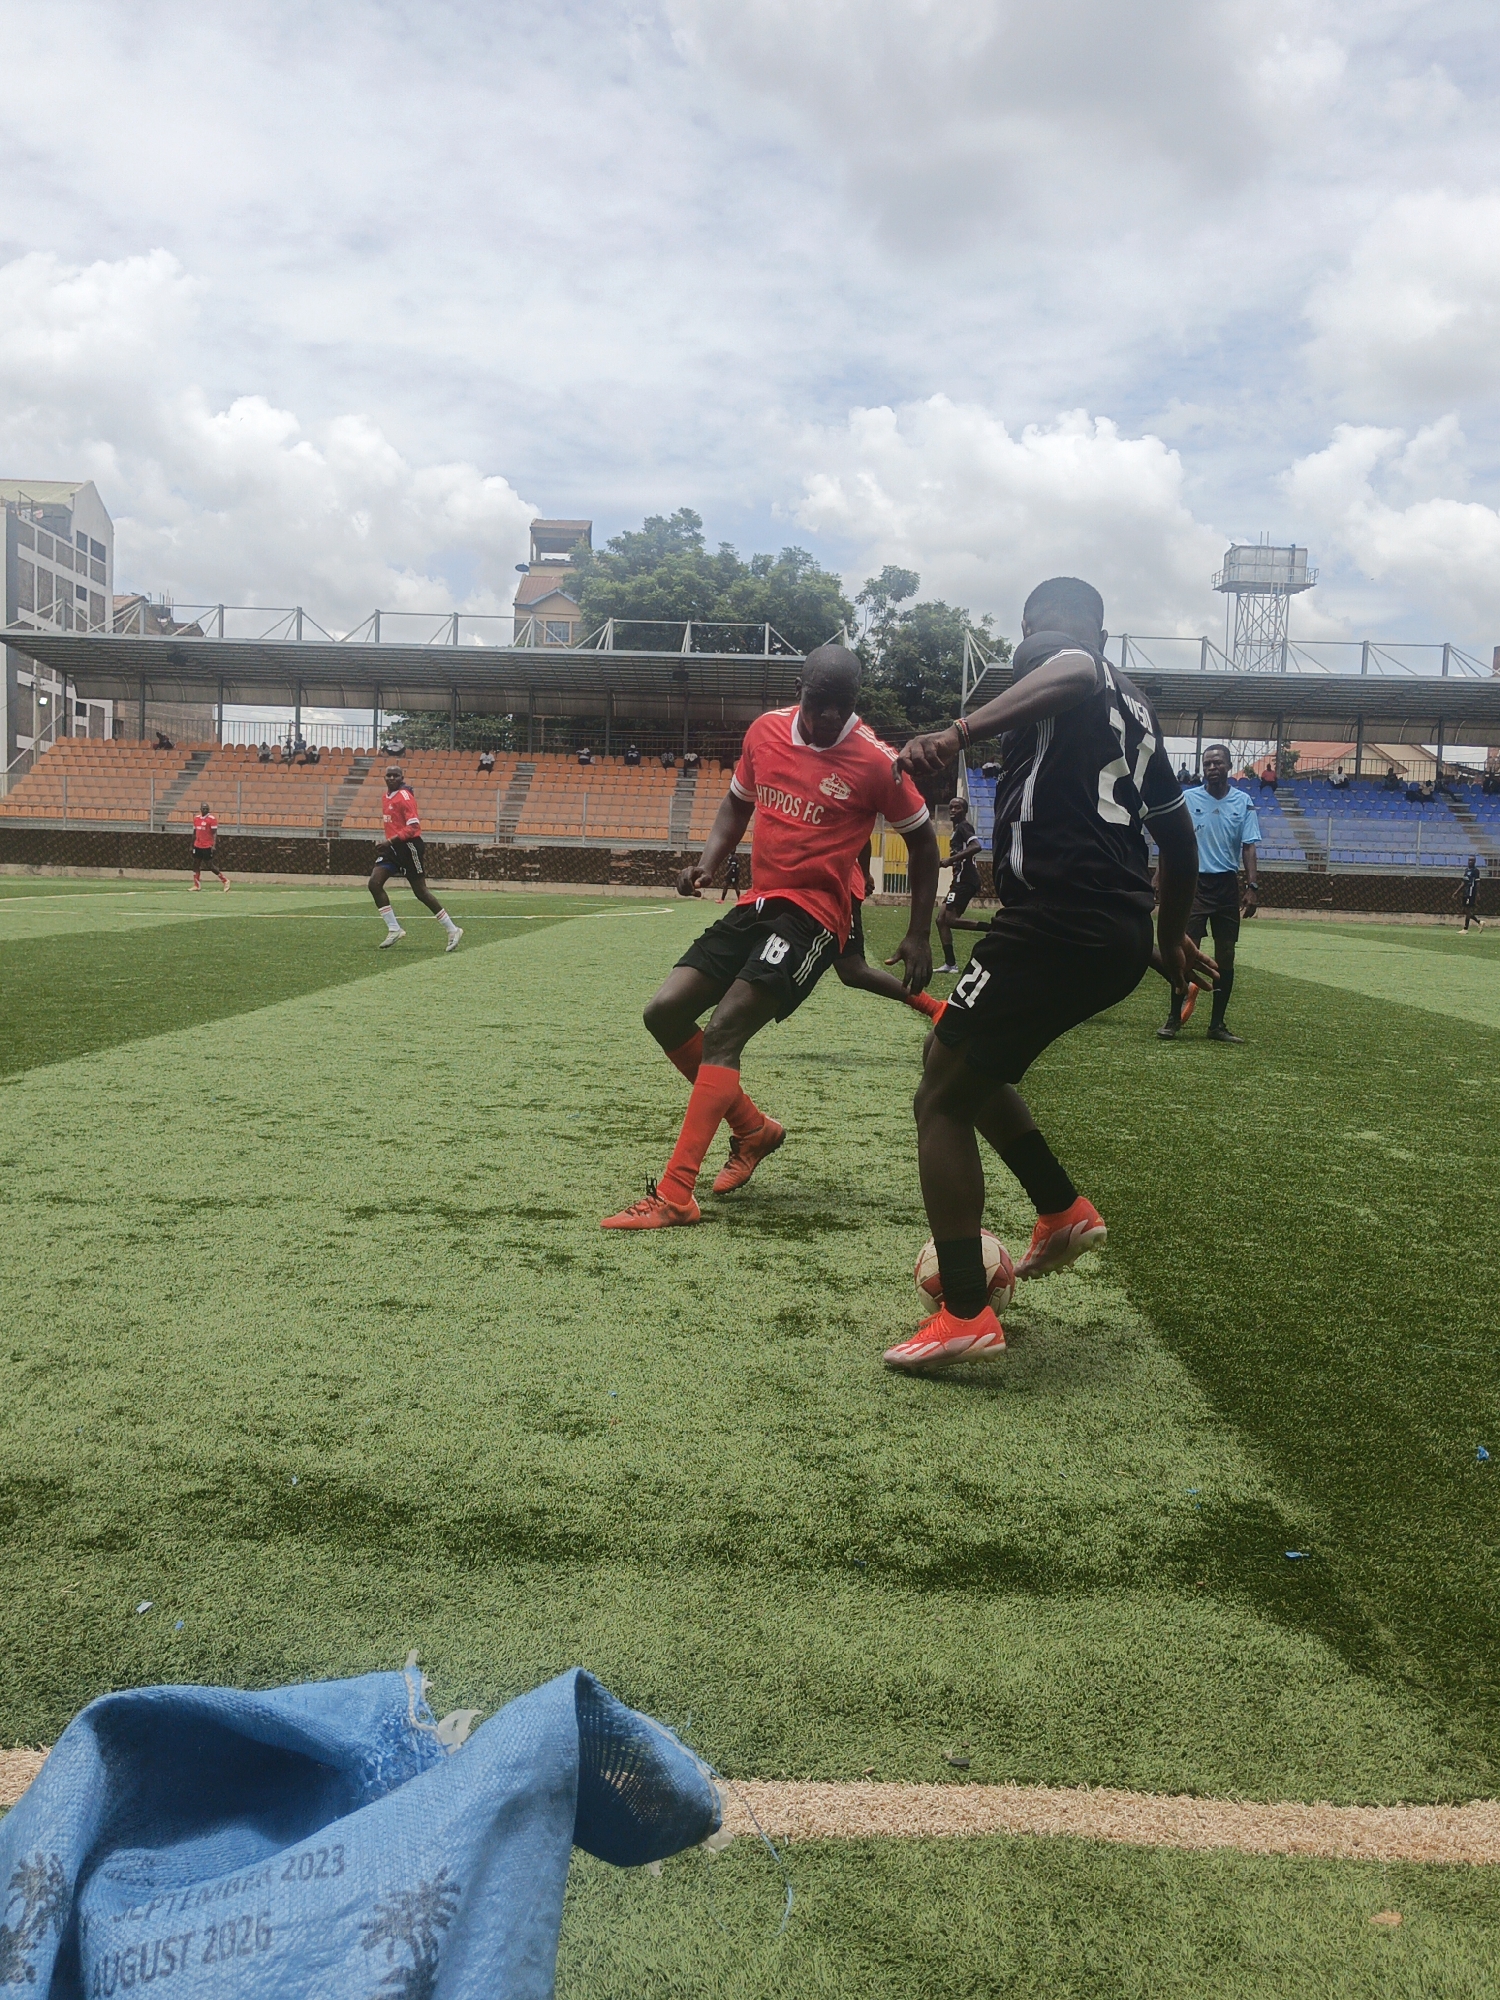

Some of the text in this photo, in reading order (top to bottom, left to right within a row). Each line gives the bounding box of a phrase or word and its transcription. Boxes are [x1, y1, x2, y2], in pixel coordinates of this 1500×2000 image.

[756, 784, 802, 817] HIPPOS
[802, 801, 825, 825] F.C
[760, 932, 791, 965] 18
[956, 957, 991, 1008] 21
[280, 1843, 345, 1882] 2023
[202, 1910, 272, 1965] 2026
